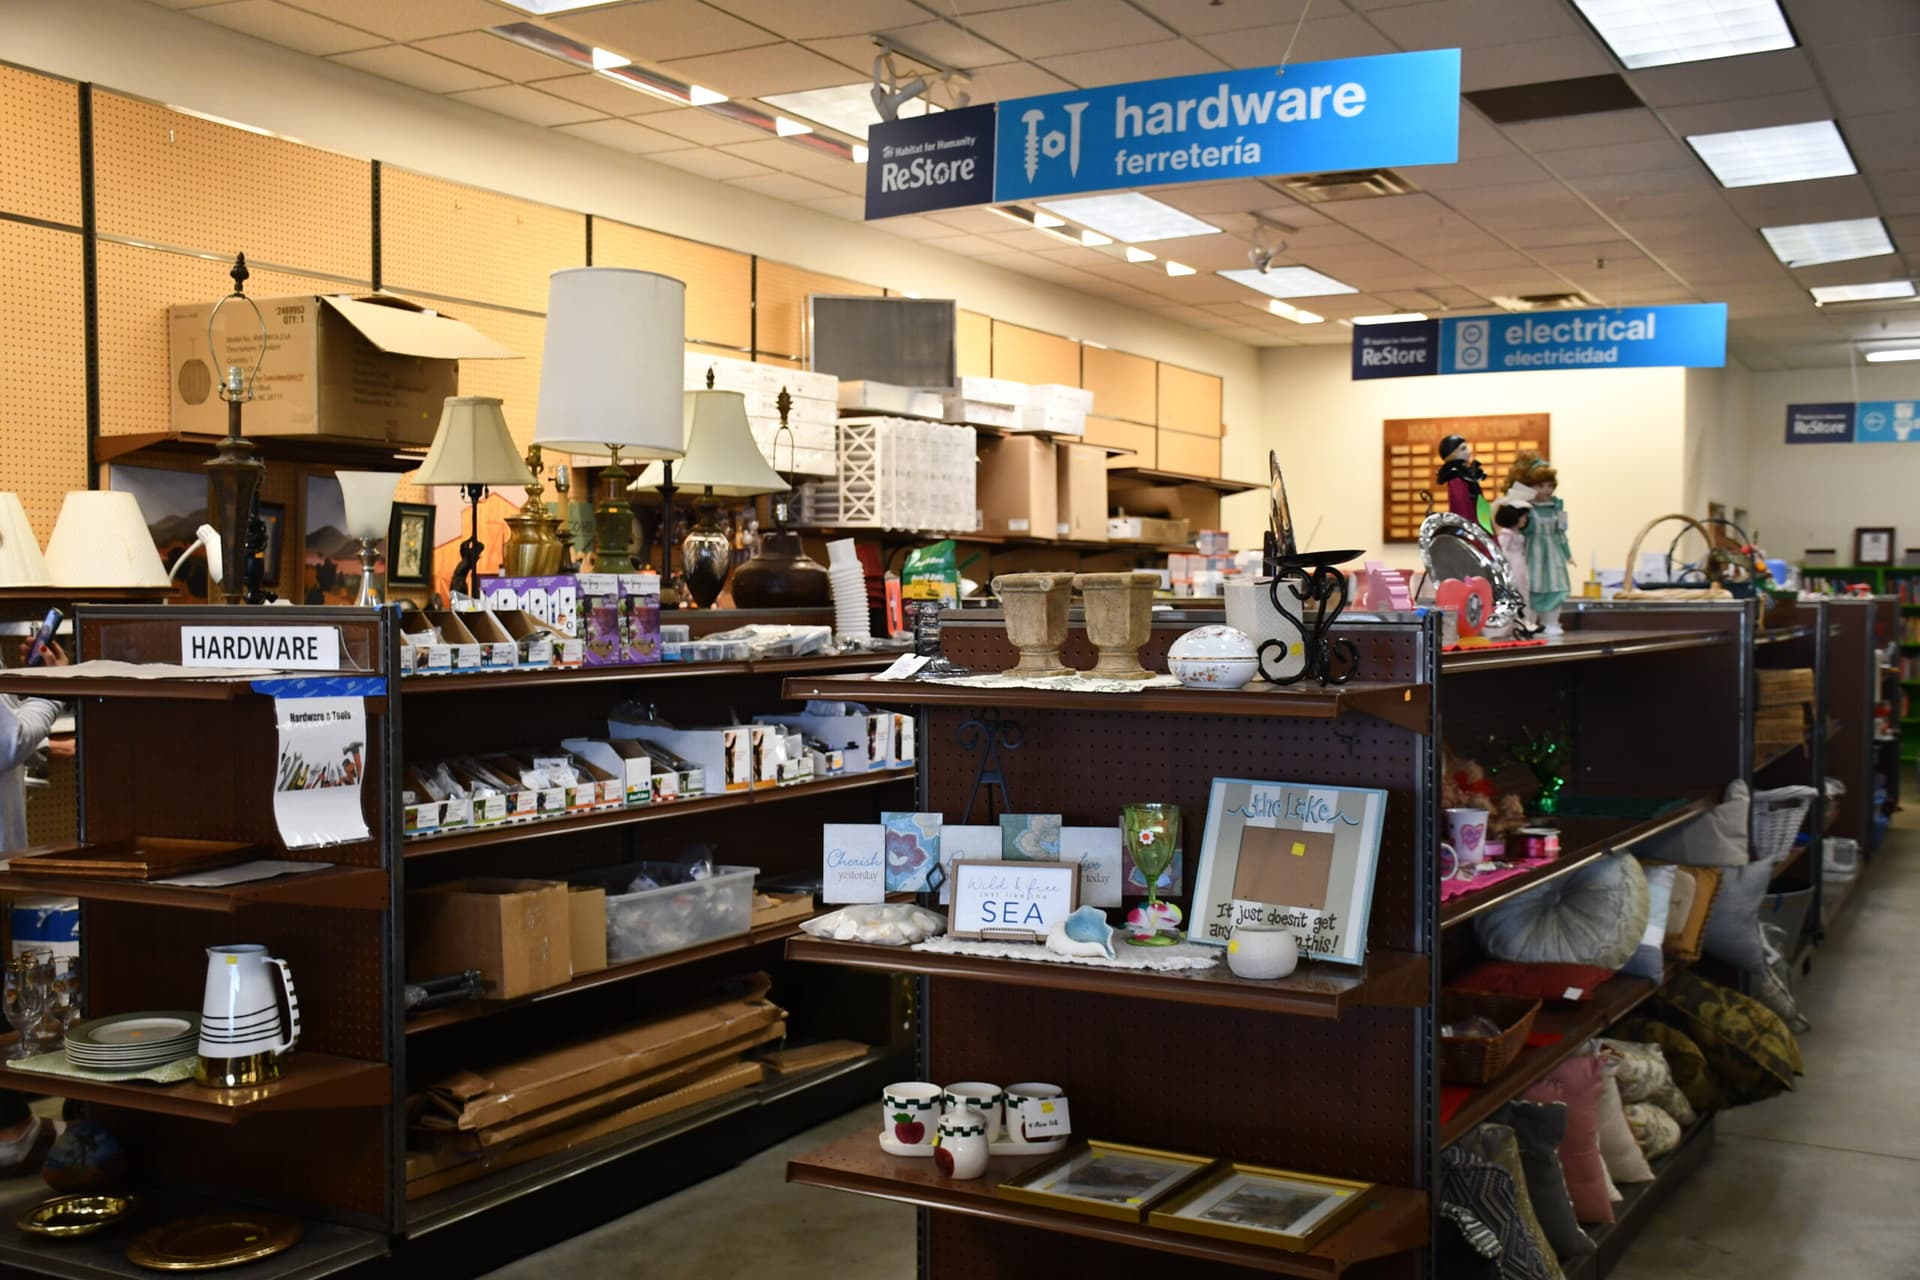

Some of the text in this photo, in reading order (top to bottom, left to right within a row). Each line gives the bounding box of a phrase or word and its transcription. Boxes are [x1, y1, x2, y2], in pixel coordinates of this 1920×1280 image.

[1114, 80, 1366, 140] hardware
[895, 136, 977, 158] Habitat for Humanity
[1114, 135, 1262, 178] ferretería
[881, 157, 975, 193] ReStore
[1504, 312, 1656, 345] electrical
[1362, 346, 1427, 367] ReStore
[1504, 346, 1618, 367] electricidad
[191, 635, 319, 661] HARDWARE
[289, 712, 325, 722] Hardware
[331, 710, 352, 720] Tools
[1252, 792, 1281, 818] the
[827, 848, 882, 868] Cherish
[838, 869, 879, 882] yesterday
[1086, 873, 1110, 885] today
[981, 900, 1044, 925] SEA
[1216, 902, 1234, 918] It
[1236, 905, 1263, 925] just
[1312, 913, 1337, 934] get
